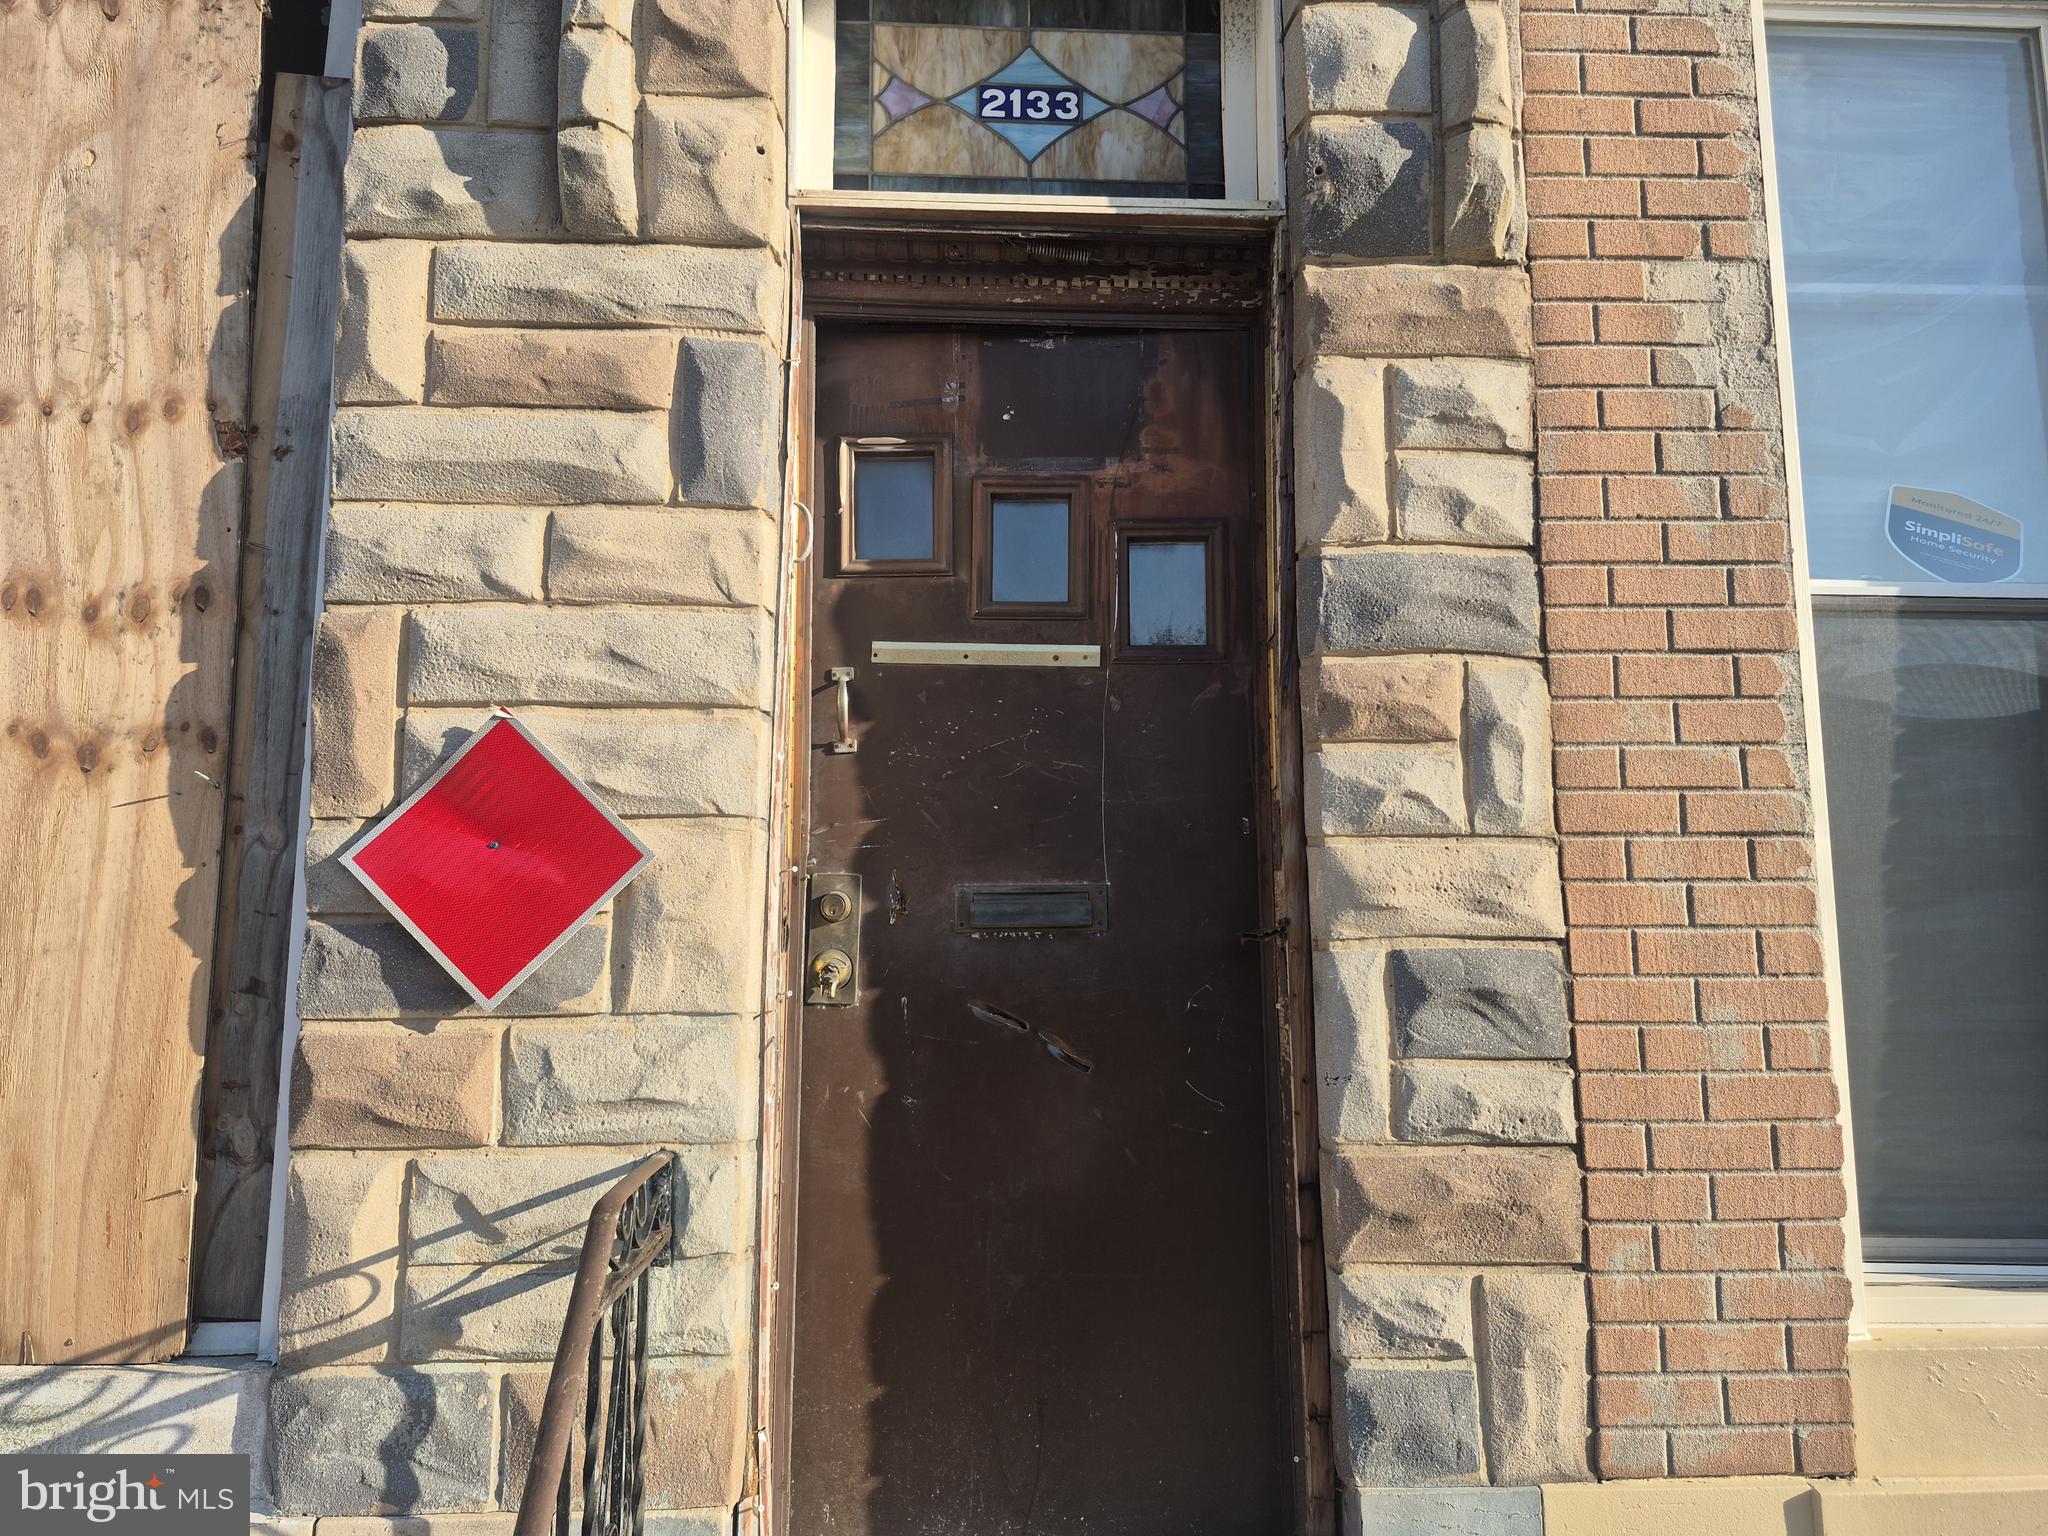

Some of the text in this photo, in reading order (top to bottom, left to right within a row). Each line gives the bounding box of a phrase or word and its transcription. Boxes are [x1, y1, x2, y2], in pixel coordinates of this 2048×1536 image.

[981, 88, 1079, 120] 2133
[1911, 497, 2002, 528] Monitored 24/7
[1904, 520, 2005, 557] SimpliSafe
[1910, 535, 1946, 550] Home
[1948, 545, 1997, 566] Security
